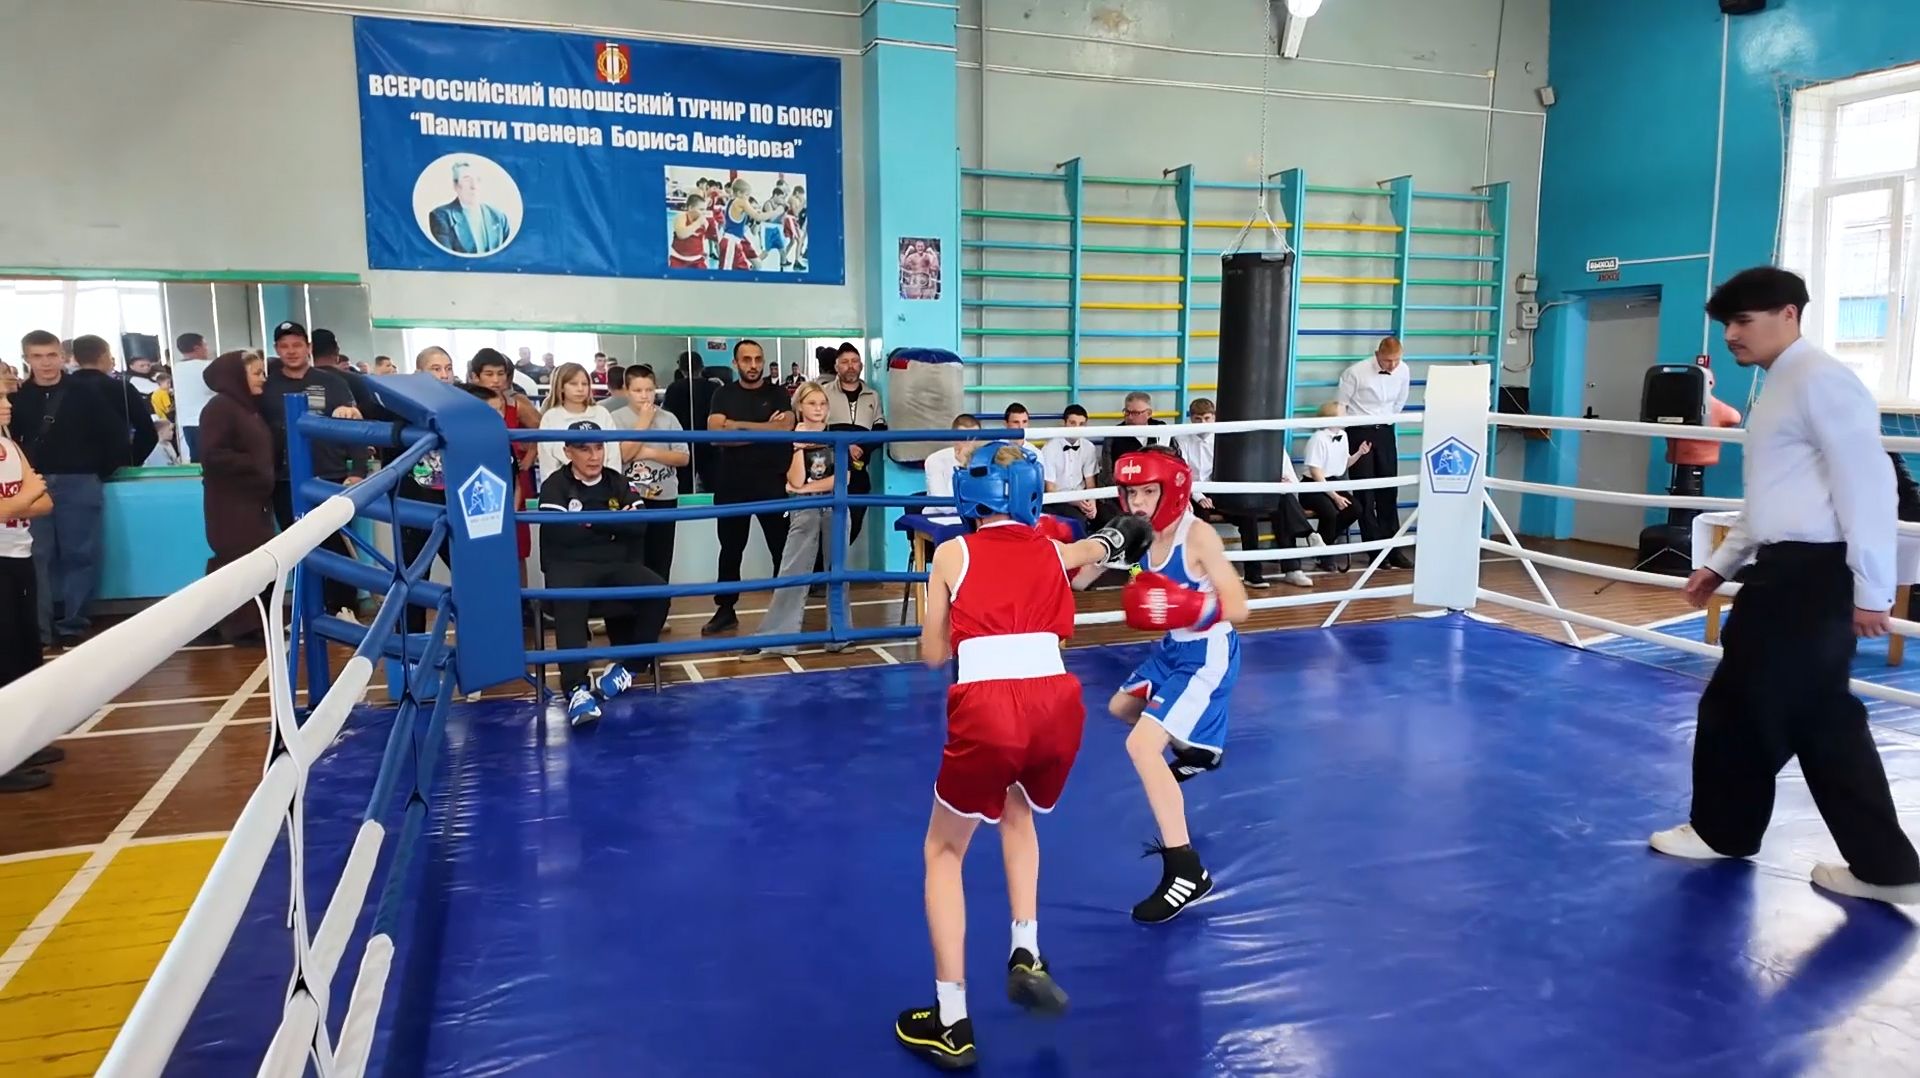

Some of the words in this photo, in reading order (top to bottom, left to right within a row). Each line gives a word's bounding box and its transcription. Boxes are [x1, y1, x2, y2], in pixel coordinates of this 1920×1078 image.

[369, 74, 544, 107] ВСЕРОССИЙСКИЙ
[548, 86, 674, 116] ЮНОШЕСКИЙ
[677, 97, 746, 122] ТУРНИР
[750, 103, 773, 124] ПО
[777, 105, 833, 128] БОКСУ
[410, 112, 507, 140] “Памяти
[511, 121, 603, 147] тренера
[611, 125, 688, 151] Бориса
[692, 131, 802, 159] Анфёрова”
